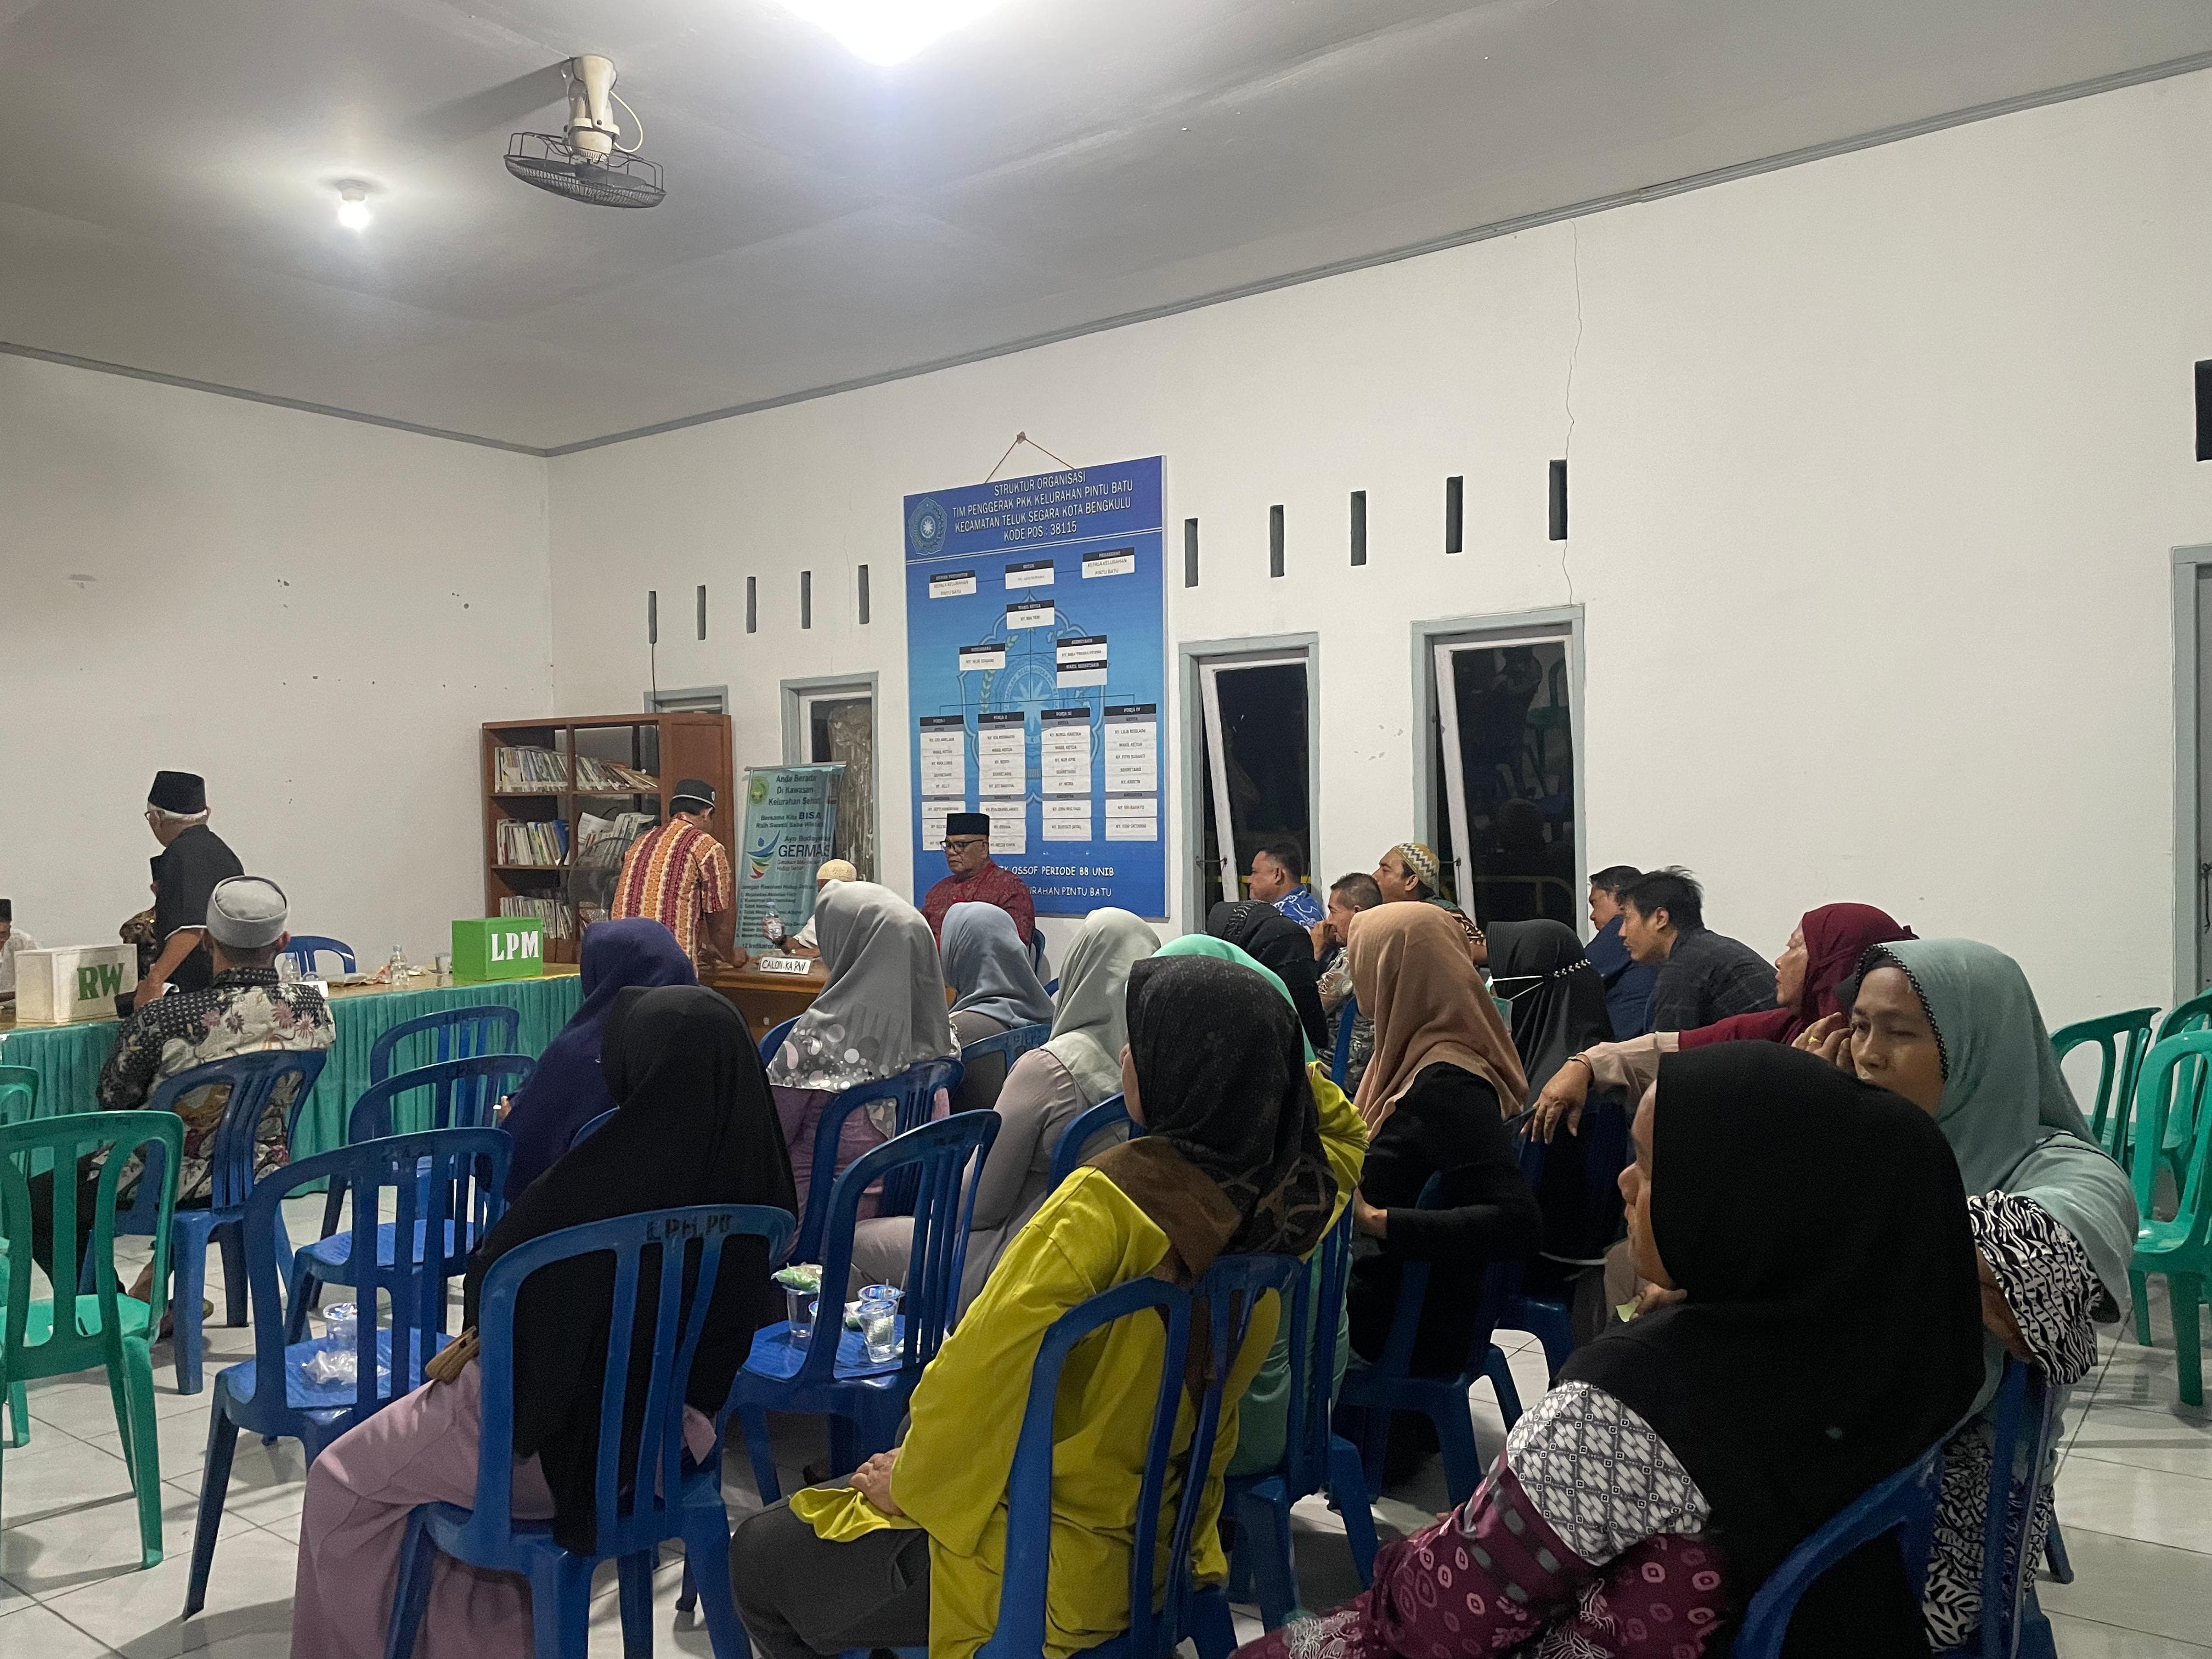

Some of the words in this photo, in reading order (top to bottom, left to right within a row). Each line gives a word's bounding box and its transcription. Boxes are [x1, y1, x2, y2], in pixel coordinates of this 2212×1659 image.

[994, 479, 1035, 496] STRUKTUR
[1037, 471, 1086, 490] ORGANISASI
[952, 507, 966, 518] TIM
[968, 498, 1014, 516] PENGGERAK
[1016, 496, 1032, 508] PKK
[1035, 488, 1082, 505] KELURAHAN
[1085, 483, 1109, 498] PINTU
[1111, 479, 1133, 494] BATU
[955, 516, 1000, 533] KECAMATAN
[1002, 513, 1026, 526] TELUK
[1028, 507, 1060, 523] SEGARA
[1062, 504, 1084, 517] KOTA
[1086, 496, 1131, 514] BENGKULU
[1003, 528, 1025, 542] KODE
[1027, 525, 1043, 538] POS
[1050, 521, 1077, 536] 38115
[776, 775, 793, 783] Anda
[769, 797, 800, 806] Kelurahan
[802, 797, 822, 805] Sehat
[799, 811, 821, 820] BISA
[784, 835, 797, 843] Ayo
[778, 843, 830, 857] GERMAS
[1011, 866, 1039, 875] OSSOF
[1041, 866, 1076, 876] PERIODE
[1079, 866, 1090, 876] 88
[1092, 866, 1115, 877] UNIB
[1061, 887, 1088, 896] PINTU
[1090, 887, 1112, 897] BATU
[491, 930, 539, 961] LPM
[77, 962, 125, 1001] RW
